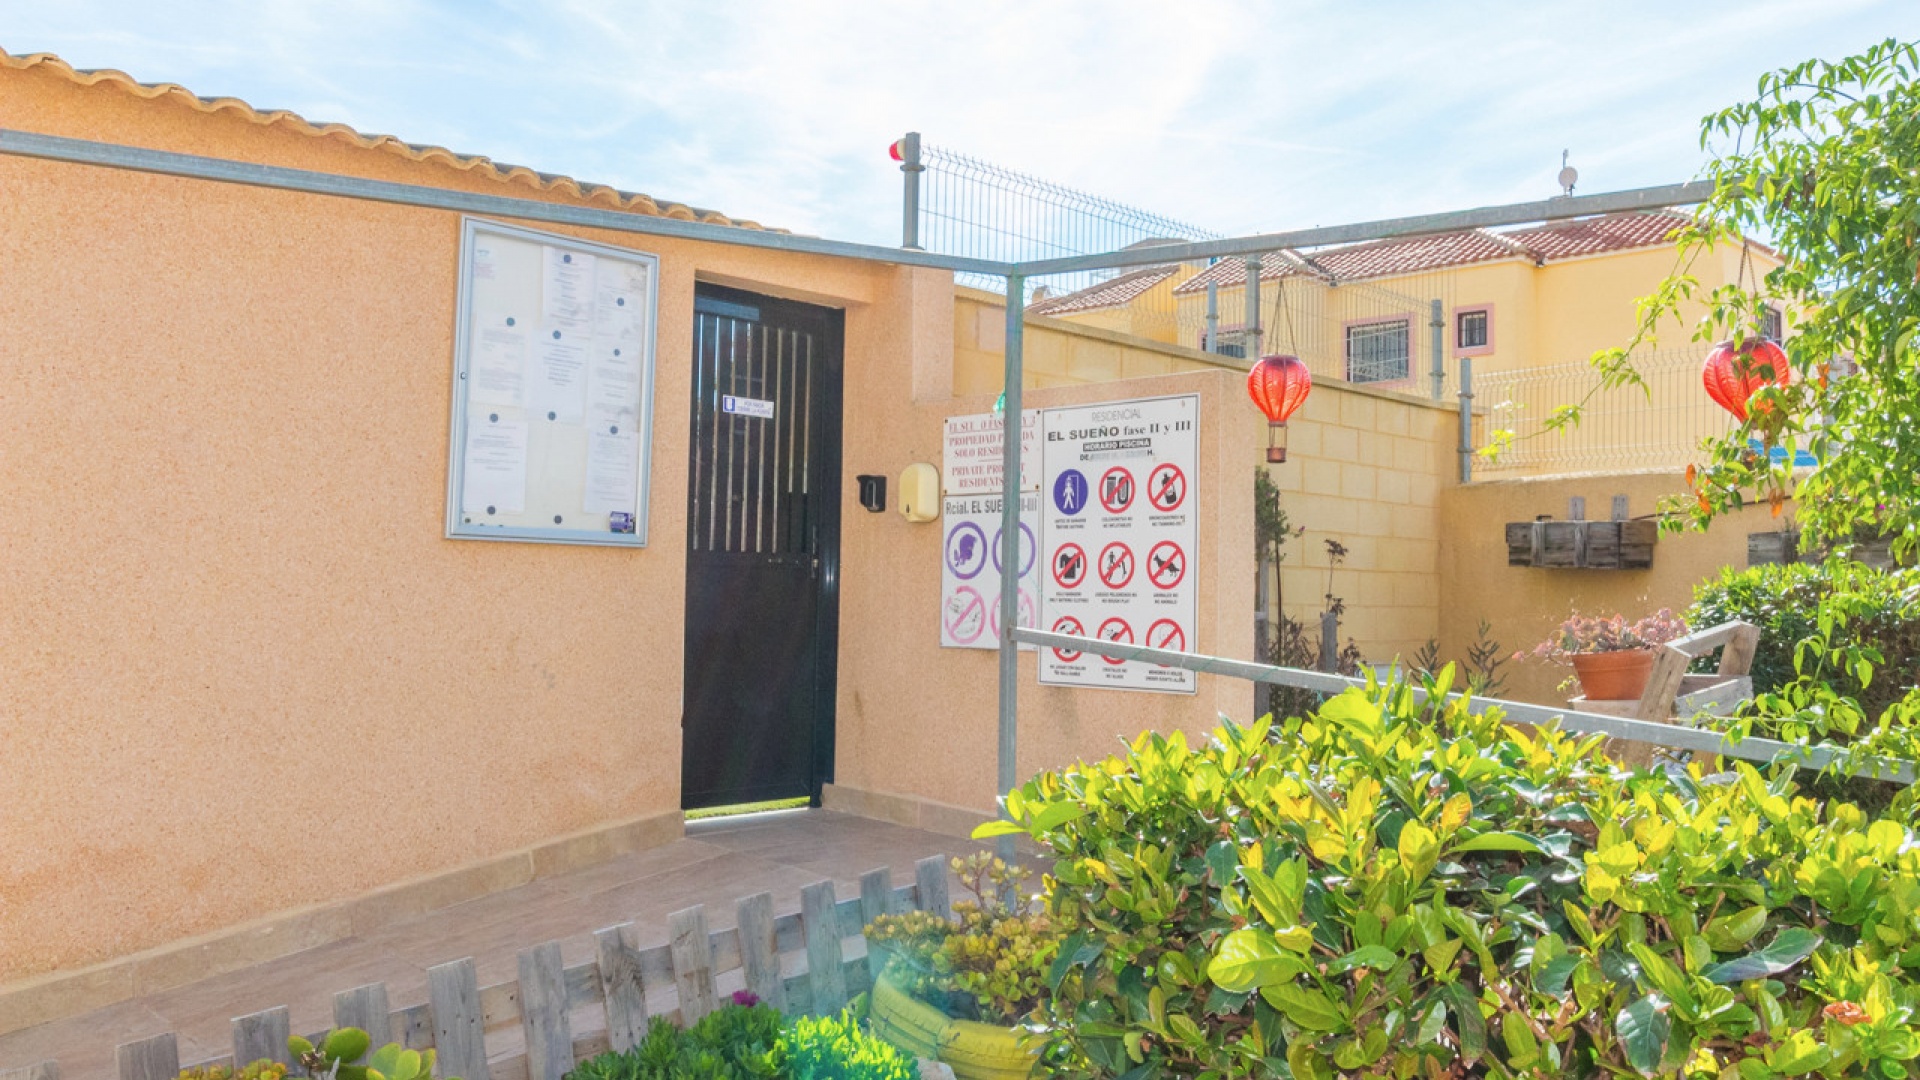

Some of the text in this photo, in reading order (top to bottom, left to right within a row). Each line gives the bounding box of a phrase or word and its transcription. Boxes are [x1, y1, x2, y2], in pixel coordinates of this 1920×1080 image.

[1048, 420, 1191, 441] EL SUEÑO fase II y III
[971, 500, 982, 514] EL
